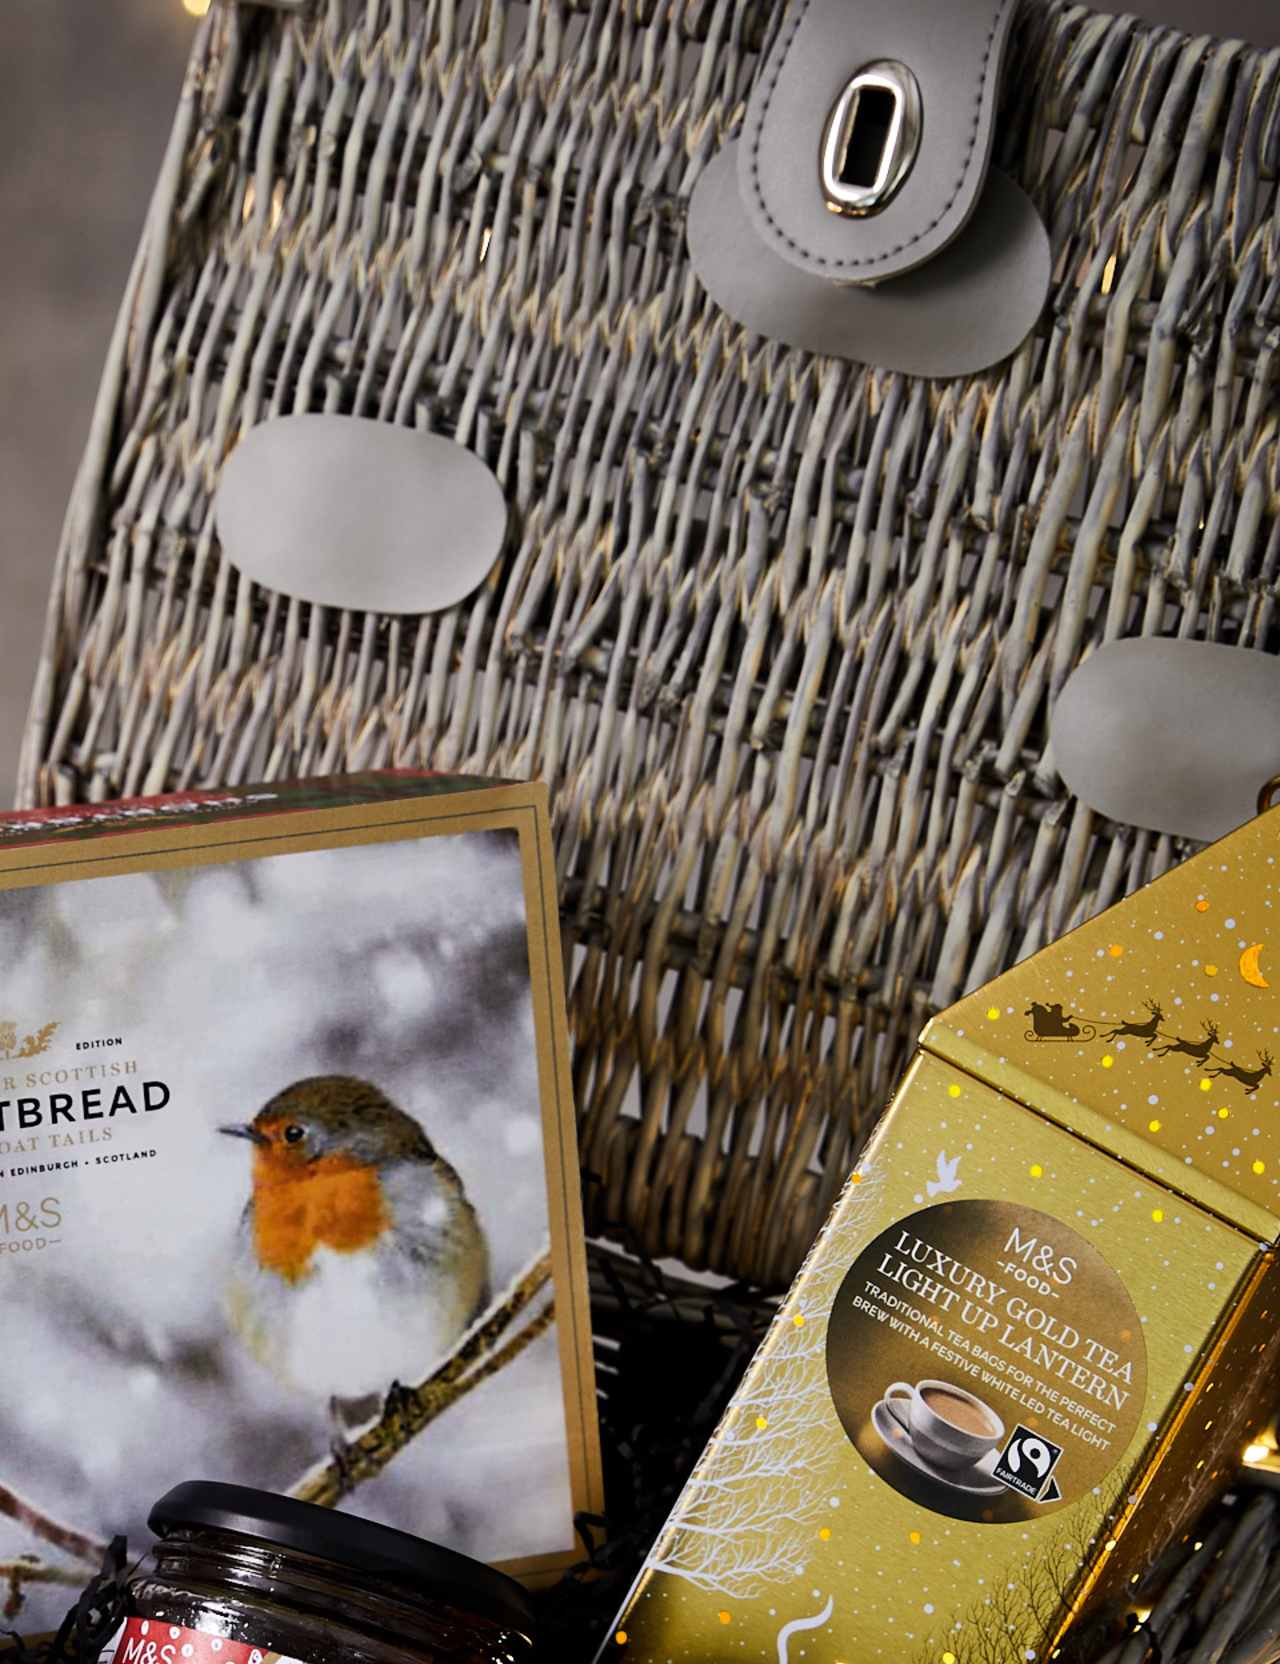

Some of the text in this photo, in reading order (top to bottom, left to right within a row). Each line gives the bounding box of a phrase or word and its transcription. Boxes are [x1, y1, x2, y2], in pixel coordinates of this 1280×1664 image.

[75, 1037, 123, 1051] EDITION
[25, 1060, 138, 1088] SCOTTISH
[48, 1126, 114, 1149] TAILS
[10, 1159, 79, 1177] EDINBURGH
[95, 1149, 157, 1165] SCOTLAND
[1003, 1227, 1077, 1285] M&S
[894, 1230, 1133, 1385] LUXURY GOLD TEA
[877, 1252, 1132, 1412] LIGHT UP LANTERN
[852, 1295, 1112, 1451] BREW WITH A FESTIVE WHITE LED TEA LIGHT
[863, 1281, 1117, 1434] TRADITIONAL TEA BAGS FOR THE PERFECT
[995, 1466, 1038, 1496] FAIRTRADE
